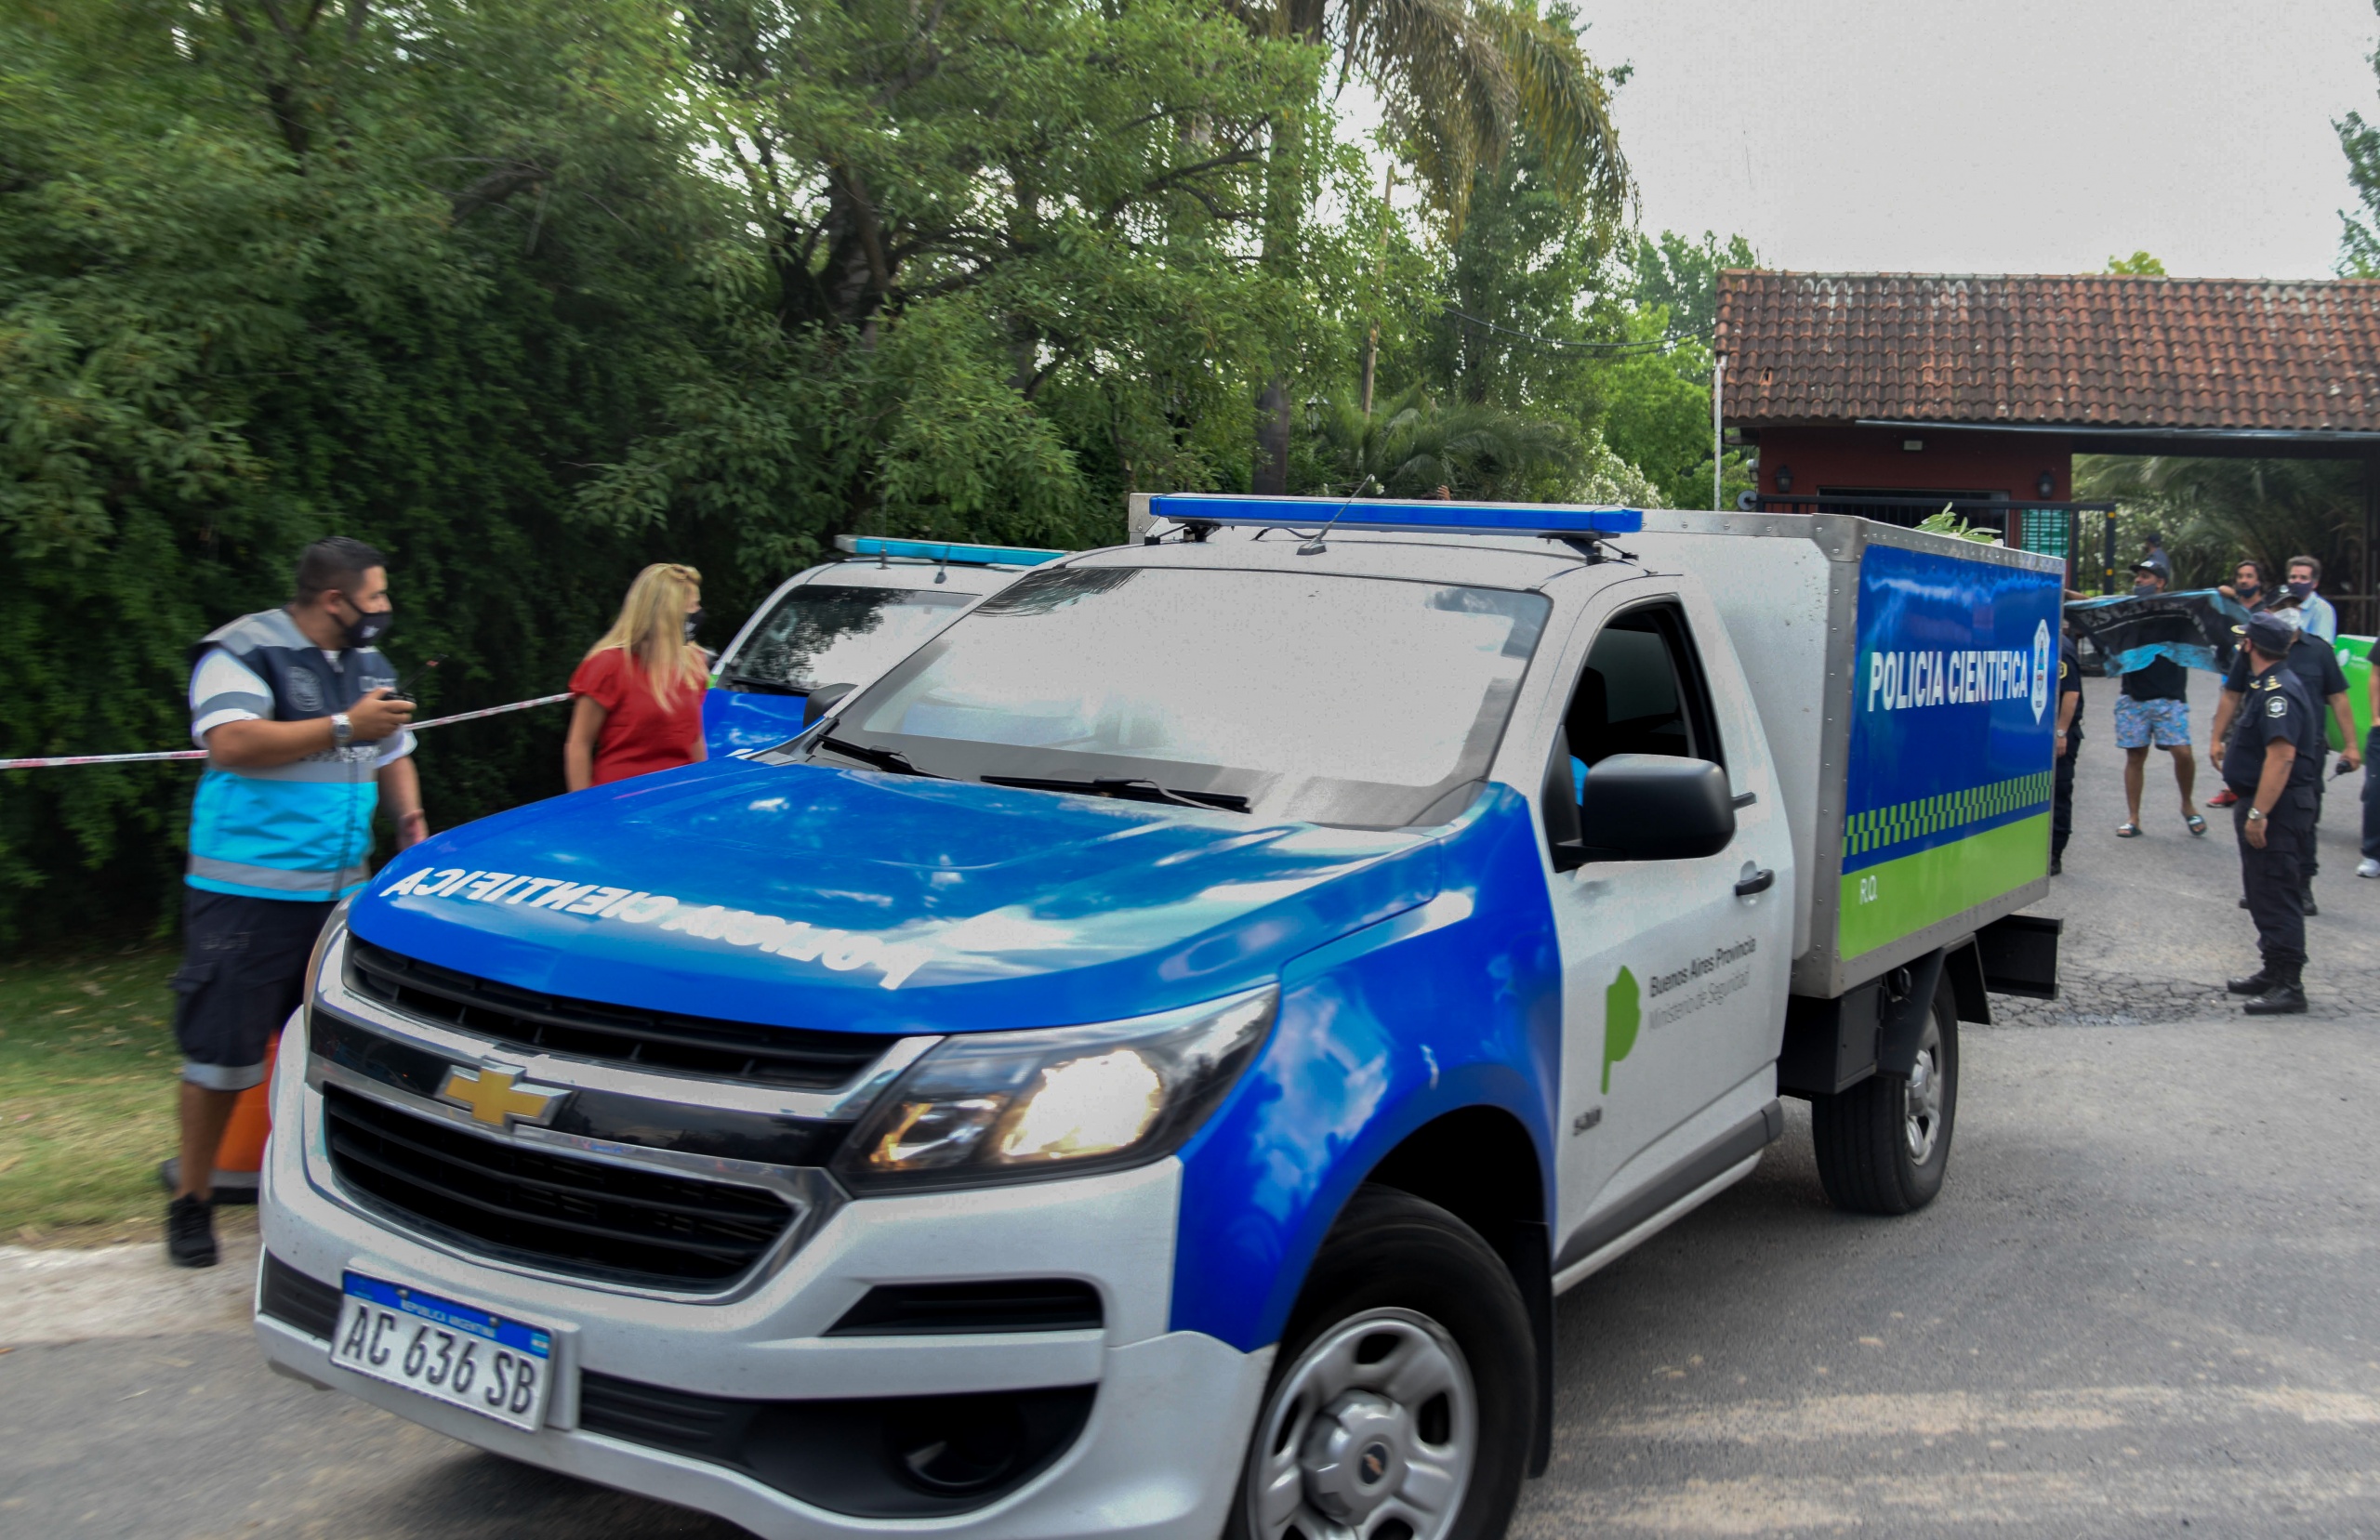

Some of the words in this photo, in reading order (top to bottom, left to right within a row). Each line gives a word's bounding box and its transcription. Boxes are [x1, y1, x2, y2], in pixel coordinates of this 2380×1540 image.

[1867, 651, 1945, 712] POLICIA
[1948, 651, 2029, 704] CIENTIFICA
[1649, 967, 1689, 998] Buenos
[1689, 956, 1714, 980] Aires
[1715, 935, 1756, 968] Provincia
[342, 1303, 397, 1366] AC
[403, 1323, 480, 1394] 636
[484, 1349, 536, 1415] SB
